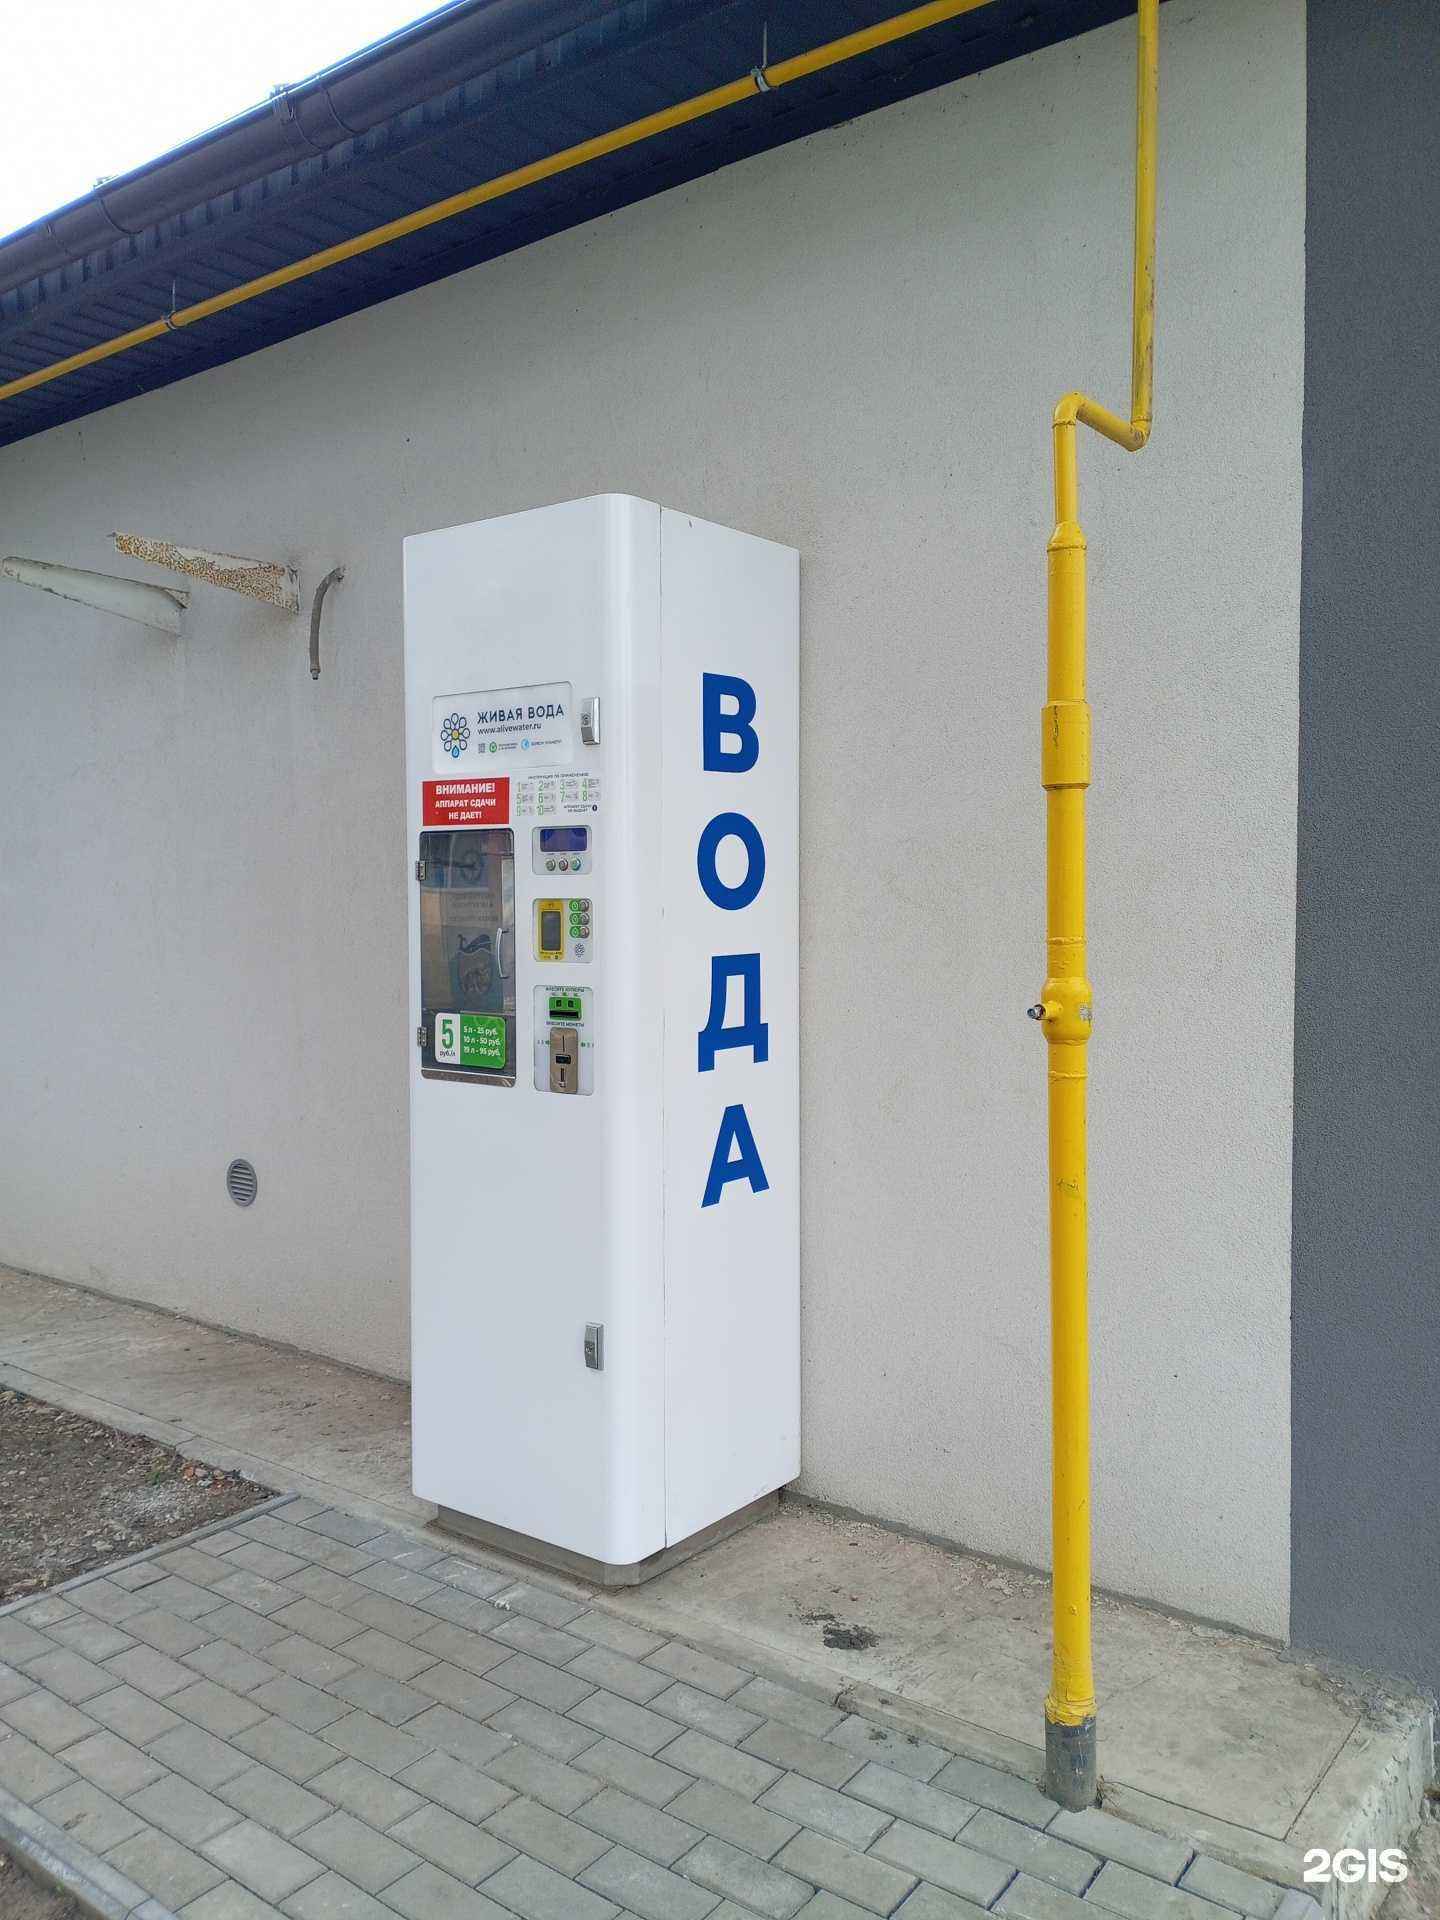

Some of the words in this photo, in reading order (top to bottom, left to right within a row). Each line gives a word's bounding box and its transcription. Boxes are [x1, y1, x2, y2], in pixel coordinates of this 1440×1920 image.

[477, 708, 522, 724] ЖИВАЯ
[528, 704, 564, 719] ВОДА
[477, 723, 541, 735] www.alivewater.ru
[436, 783, 495, 795] ВНИМАНИЕ!
[435, 799, 469, 808] АППАРАТ
[470, 799, 496, 808] СДАЧИ
[448, 812, 459, 820] НЕ
[460, 811, 482, 821] ДАЕТ!
[697, 672, 770, 1208] ВОДА
[442, 1019, 454, 1049] 5
[488, 1039, 501, 1047] руб.
[487, 1049, 501, 1057] руб.
